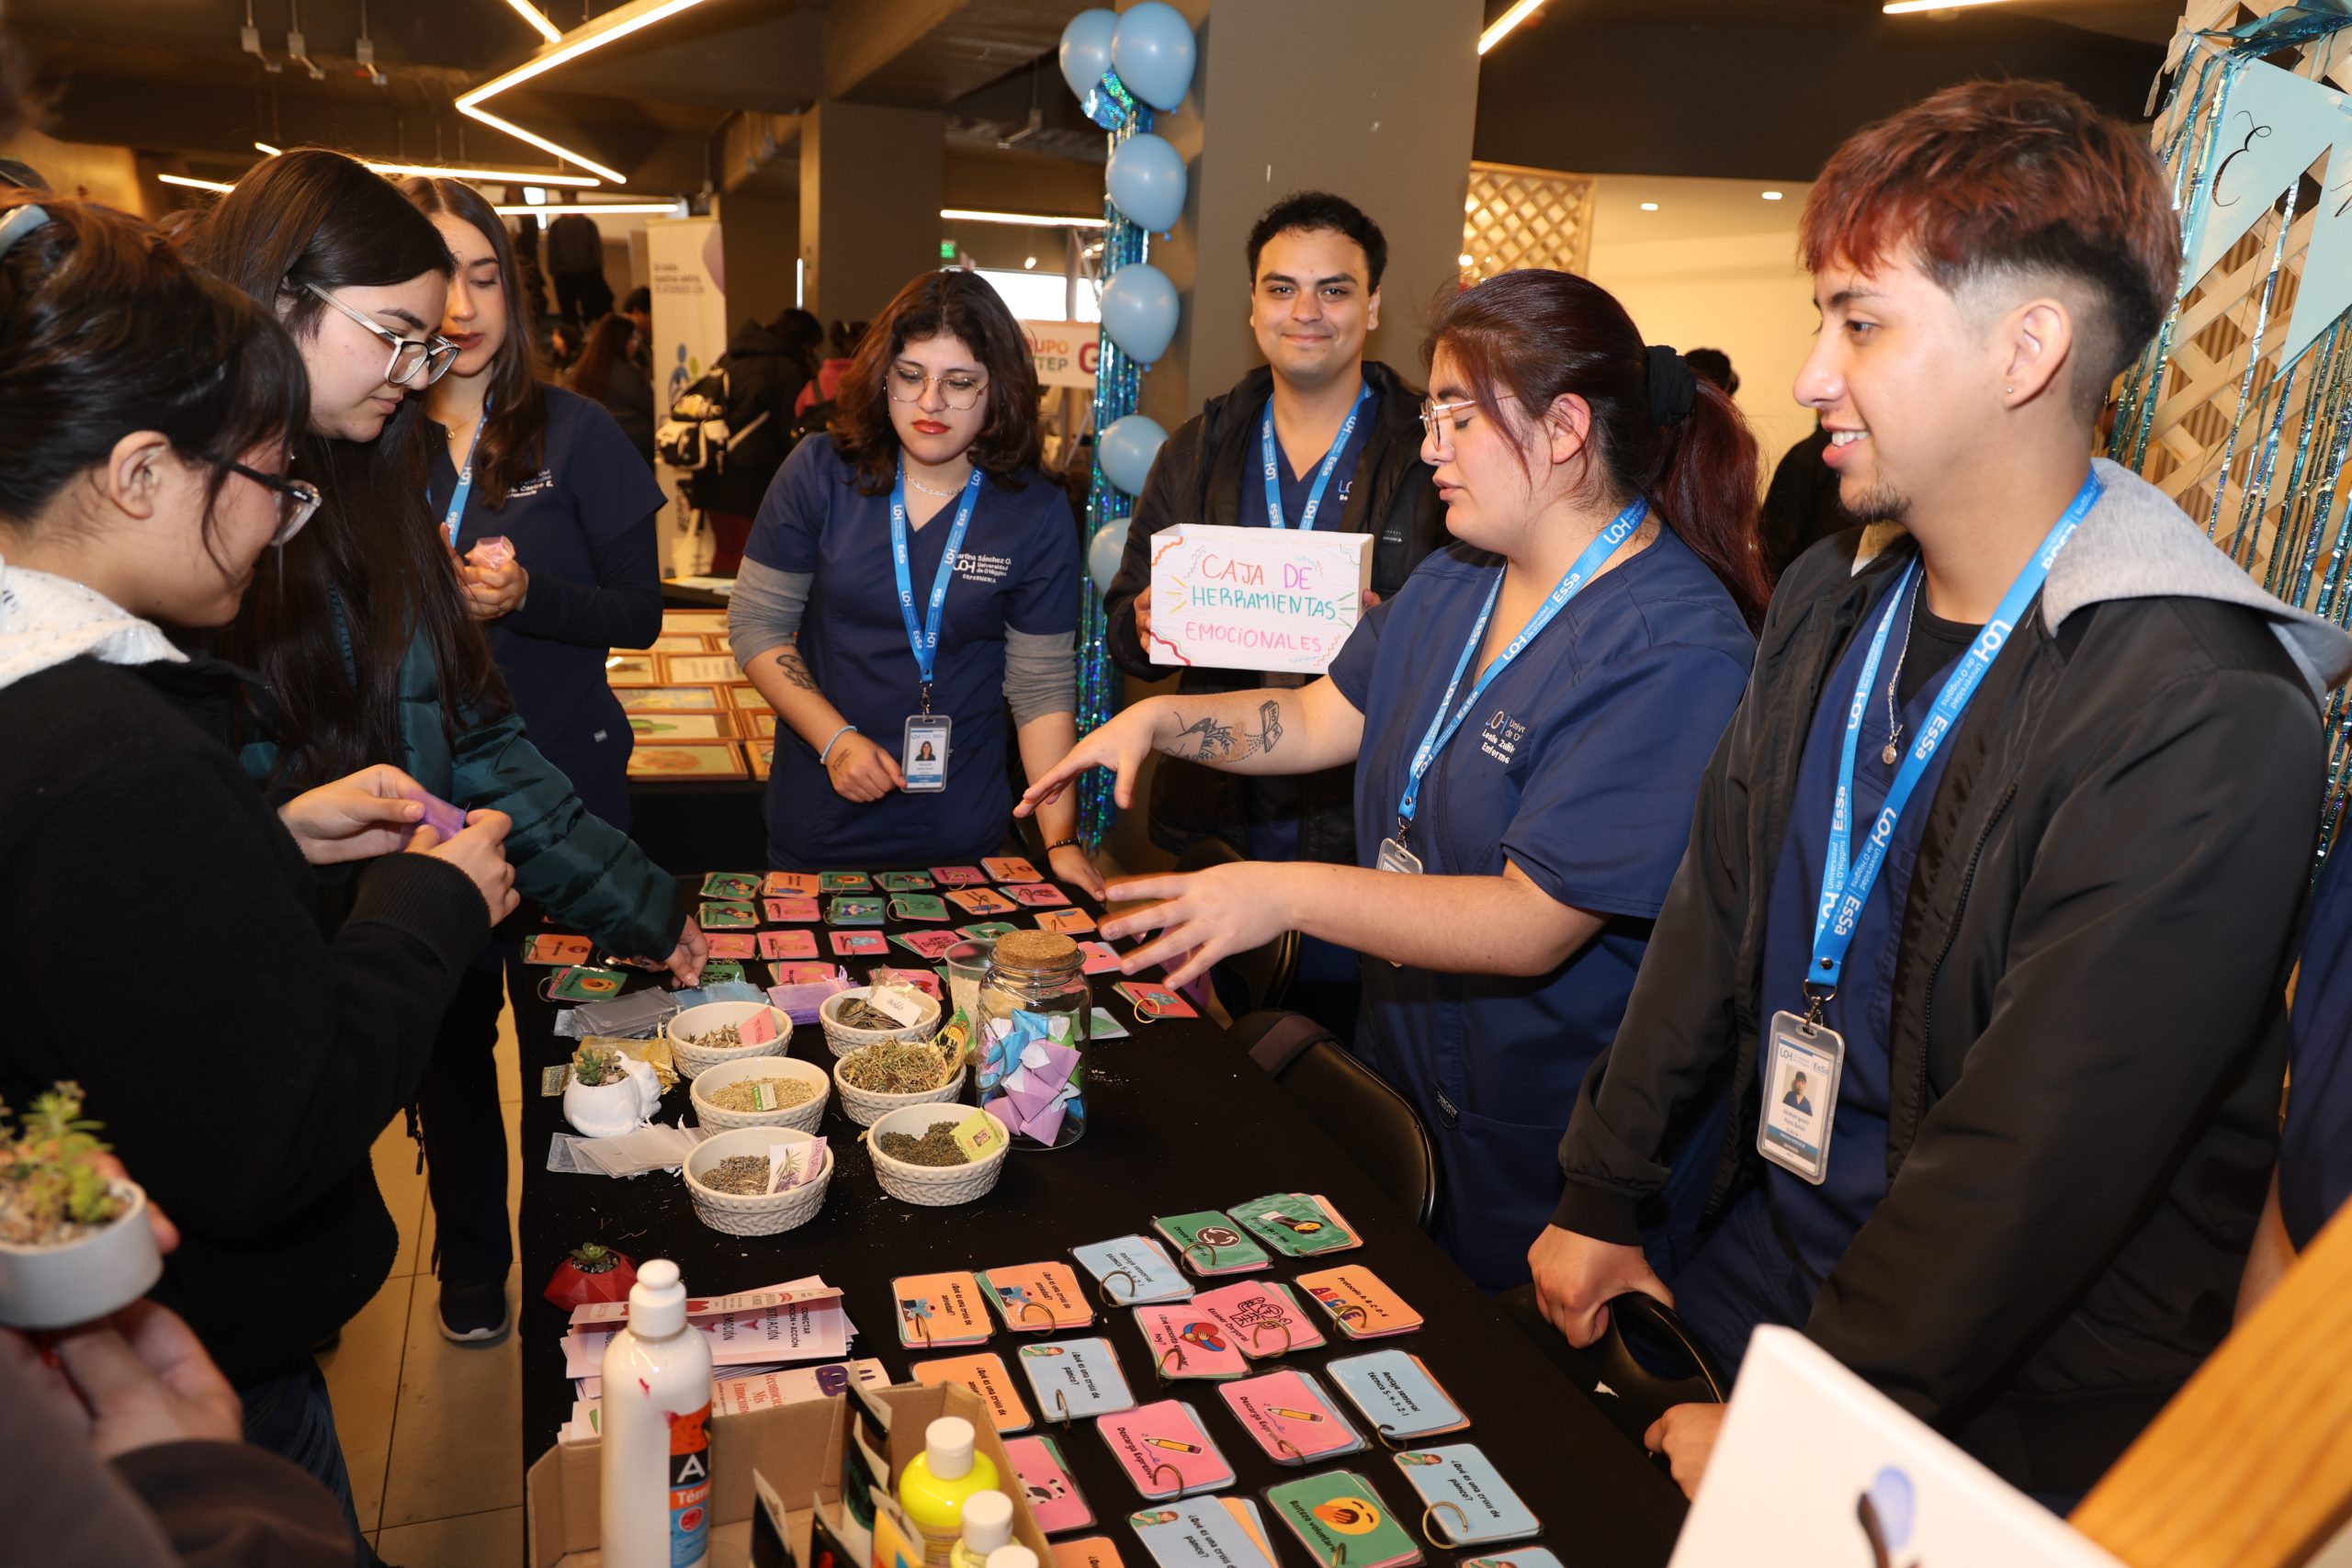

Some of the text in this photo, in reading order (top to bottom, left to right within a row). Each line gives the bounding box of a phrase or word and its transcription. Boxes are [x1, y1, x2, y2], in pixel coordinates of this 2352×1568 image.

[1202, 554, 1312, 590] CAJA DE
[1552, 572, 1580, 604] EsSa
[1964, 657, 1975, 670] de
[1950, 662, 1984, 710] Universidad
[1915, 715, 1949, 761] EsSa
[1833, 785, 1847, 831] EsSa
[1866, 841, 1874, 853] de
[1827, 840, 1838, 890] Universidad
[1860, 847, 1882, 891] Universidad
[1837, 880, 1844, 891] de
[1834, 895, 1861, 936] EsSa
[1338, 1277, 1362, 1296] Protocolo
[801, 1306, 811, 1335] CONECTAR
[1225, 1323, 1250, 1342] Corporal
[790, 1326, 801, 1348] ACCIÓN
[1154, 1332, 1167, 1347] hoy?
[1080, 1368, 1091, 1379] una
[1084, 1378, 1097, 1392] crisis
[752, 1390, 766, 1404] Mis
[985, 1385, 996, 1395] una
[990, 1395, 1003, 1409] crisis
[1381, 1371, 1421, 1412] Anclaje sensorial
[997, 1408, 1007, 1416] de
[1239, 1395, 1261, 1421] Descarga
[1116, 1427, 1137, 1452] Descarga
[675, 1453, 707, 1483] A
[1451, 1460, 1468, 1474] ¿Qué
[1468, 1482, 1481, 1494] una
[1476, 1493, 1494, 1509] crisis
[1489, 1509, 1500, 1518] de
[1289, 1500, 1312, 1522] Bostezo
[1204, 1536, 1218, 1549] una
[1214, 1548, 1232, 1564] crisis
